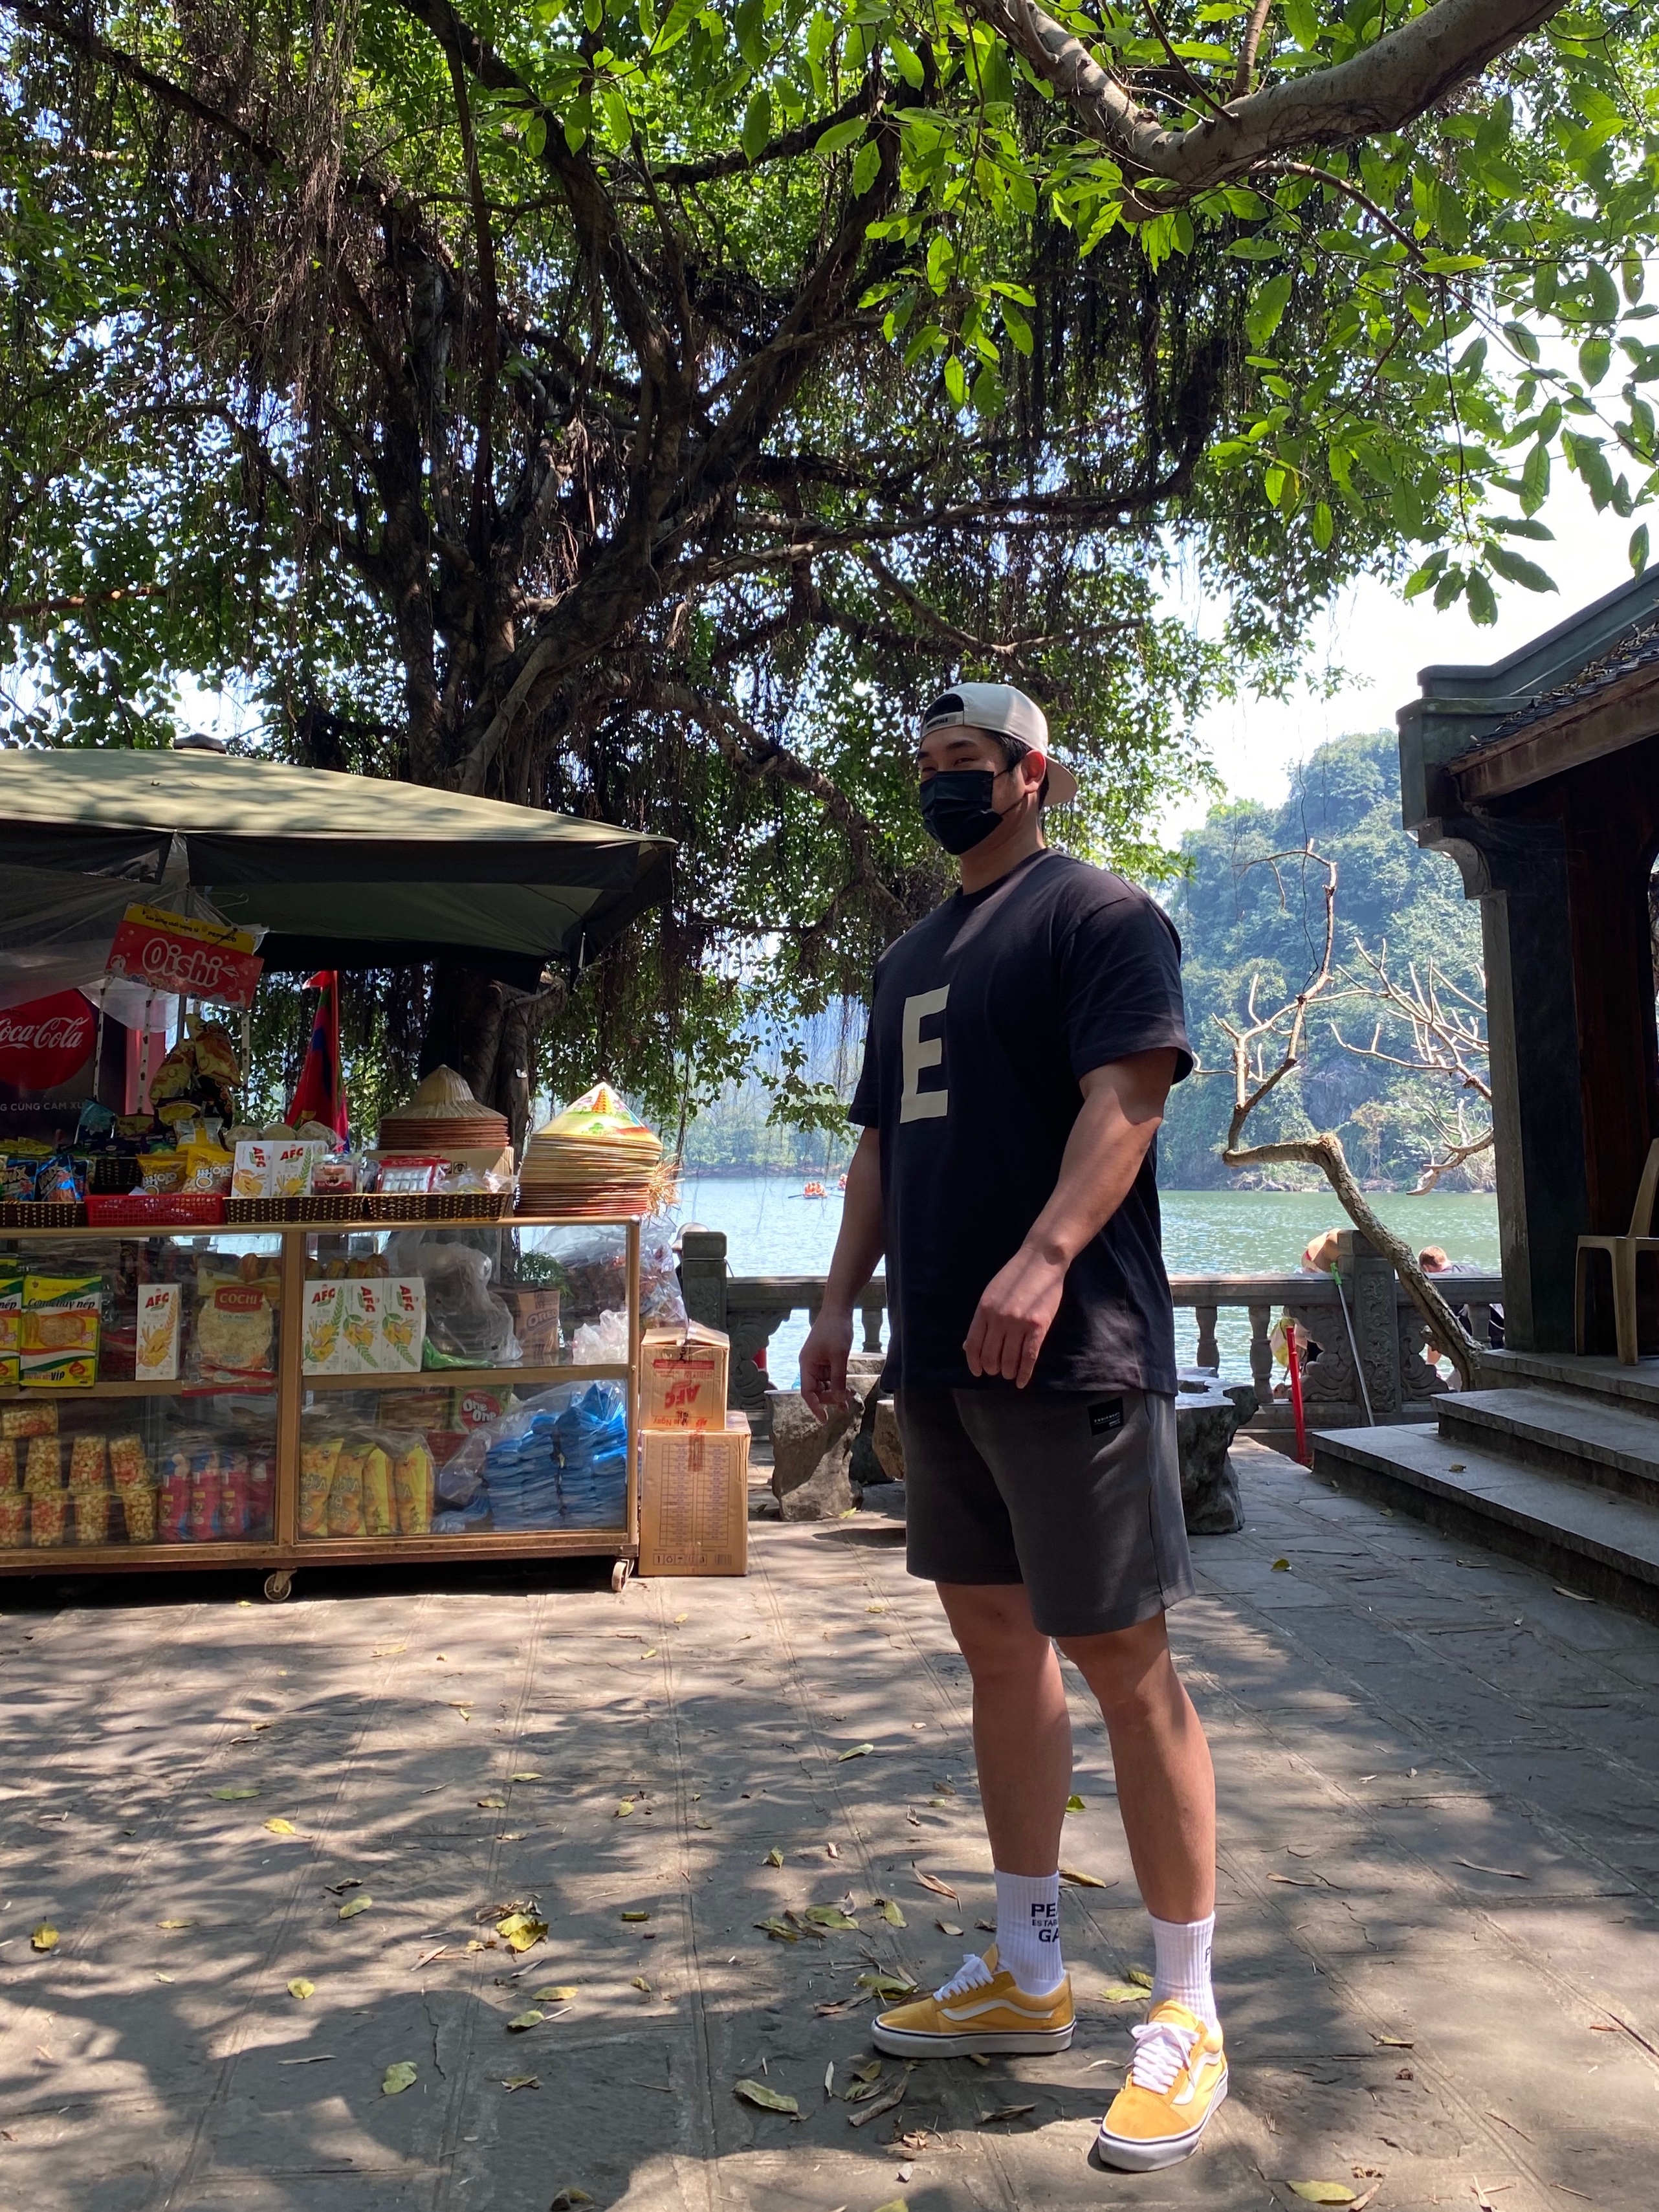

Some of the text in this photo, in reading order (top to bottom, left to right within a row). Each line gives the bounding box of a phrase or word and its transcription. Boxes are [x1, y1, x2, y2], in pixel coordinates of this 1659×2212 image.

[142, 937, 223, 988] Oishi
[900, 983, 950, 1123] E
[253, 1147, 267, 1167] AFC
[280, 1147, 303, 1160] AFC
[146, 1292, 169, 1309] AFC
[219, 1294, 258, 1305] COCHI
[312, 1288, 335, 1305] AFC
[360, 1286, 375, 1312] AFC
[400, 1285, 414, 1311] AFC
[527, 1309, 558, 1329] OREO
[463, 1399, 488, 1413] One
[665, 1384, 701, 1410] AFC
[472, 1410, 496, 1422] One
